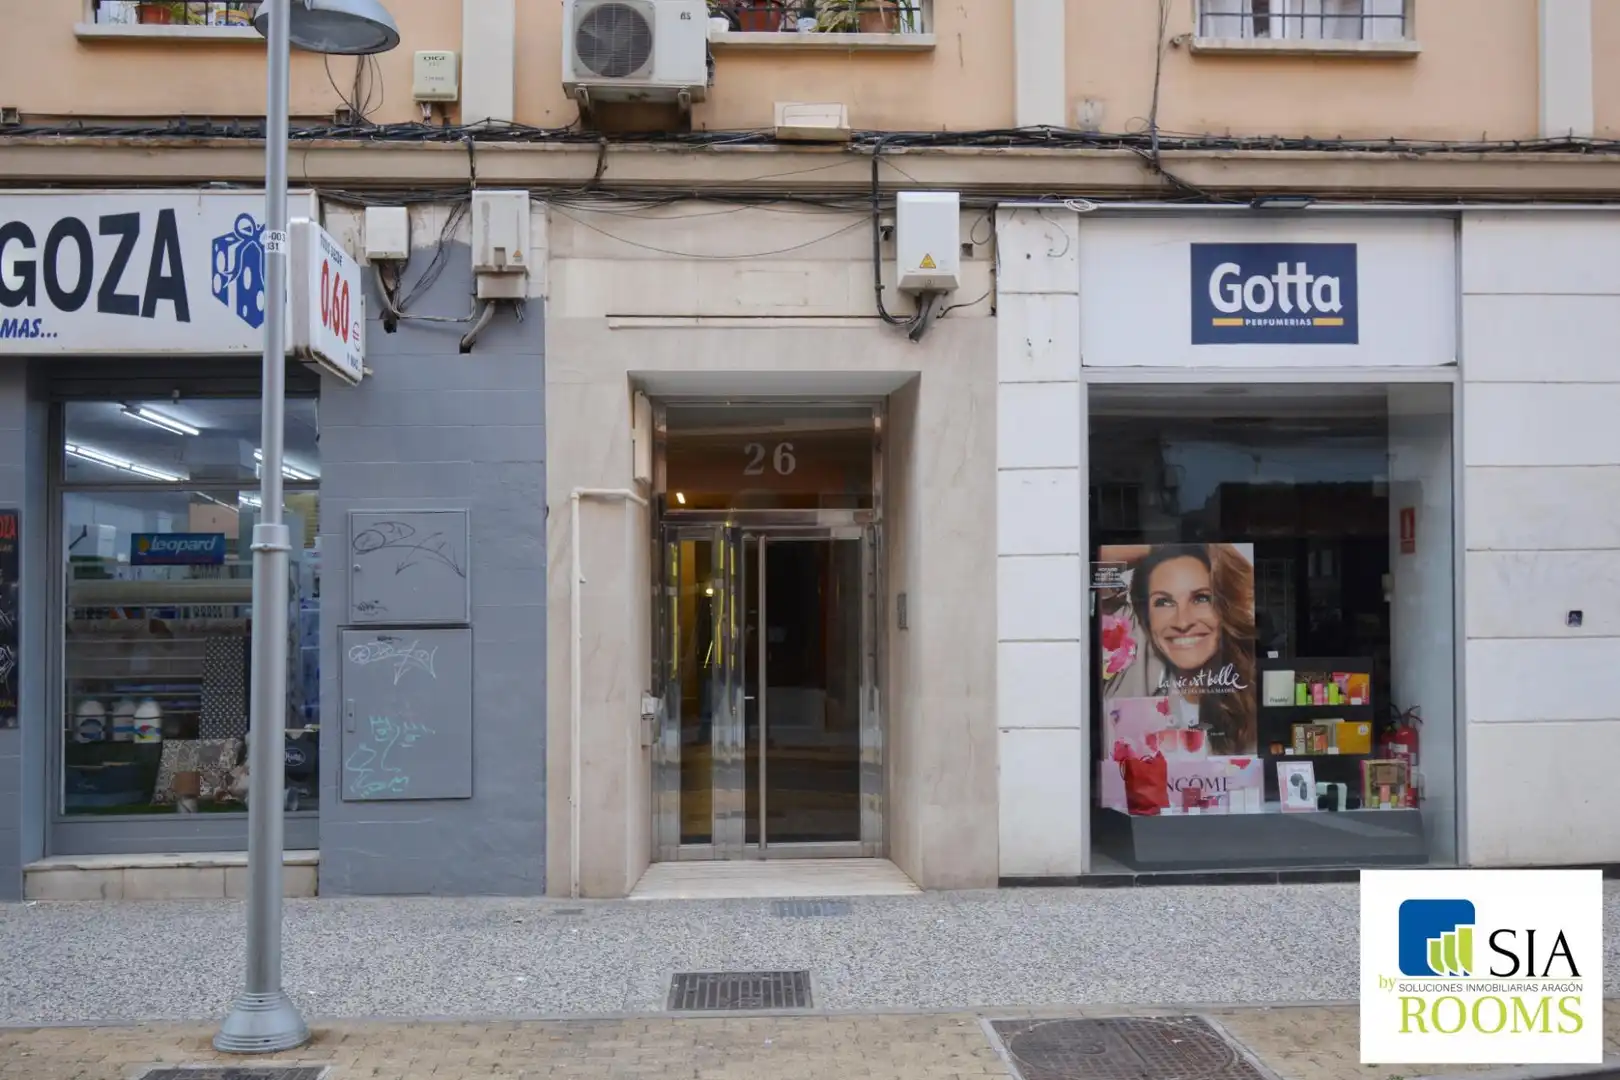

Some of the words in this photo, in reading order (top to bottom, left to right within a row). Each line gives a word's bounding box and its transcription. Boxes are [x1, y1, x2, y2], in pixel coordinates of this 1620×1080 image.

[0, 208, 190, 323] GOZA
[1208, 262, 1343, 314] Gotta
[1245, 318, 1312, 327] PERFUMERIAS
[743, 442, 796, 475] 26
